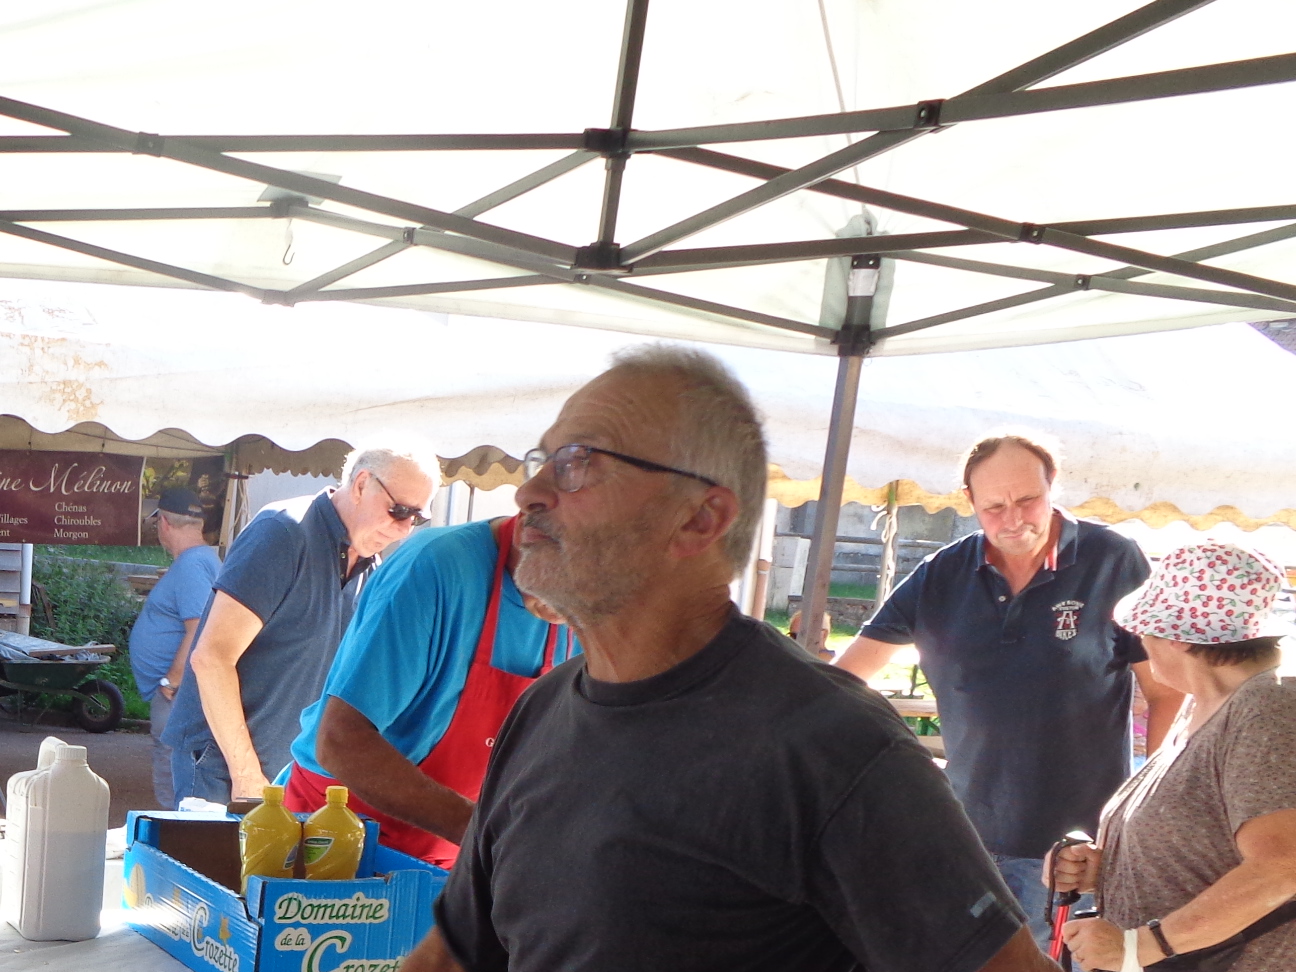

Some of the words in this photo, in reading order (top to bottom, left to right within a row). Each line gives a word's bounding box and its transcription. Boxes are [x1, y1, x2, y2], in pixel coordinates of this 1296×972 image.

[30, 462, 135, 495] Mélinon
[55, 501, 87, 512] Chénas
[54, 515, 101, 526] Chiroubles
[54, 528, 89, 540] Morgon
[277, 896, 385, 921] Domaine
[280, 933, 292, 946] de
[295, 933, 305, 946] la
